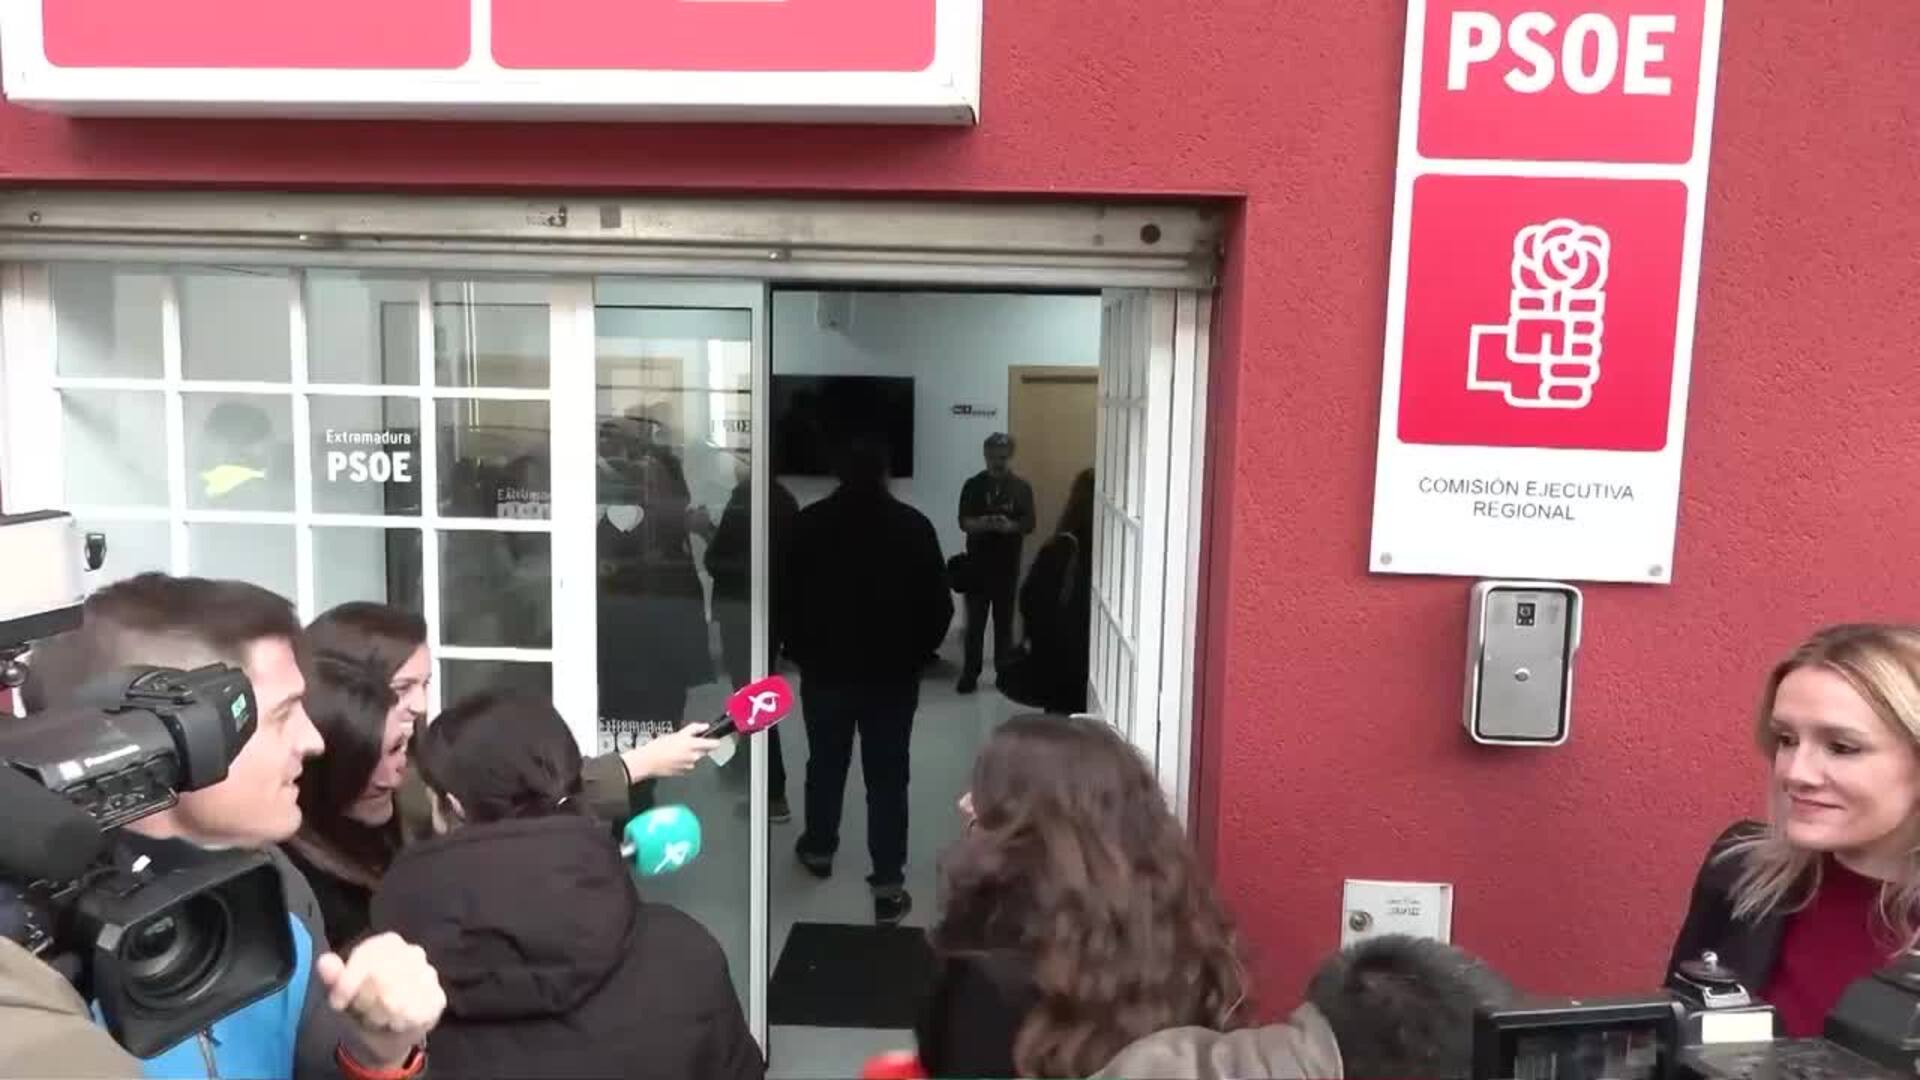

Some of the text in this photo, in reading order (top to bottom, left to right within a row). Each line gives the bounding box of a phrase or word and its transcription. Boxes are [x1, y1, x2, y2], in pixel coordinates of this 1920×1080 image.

[1447, 11, 1677, 96] PSOE
[326, 429, 412, 445] Extremadura
[327, 451, 412, 483] PSOE
[1418, 477, 1635, 500] COMISIÓN EJECUTIVA
[1472, 501, 1576, 520] REGIONAL
